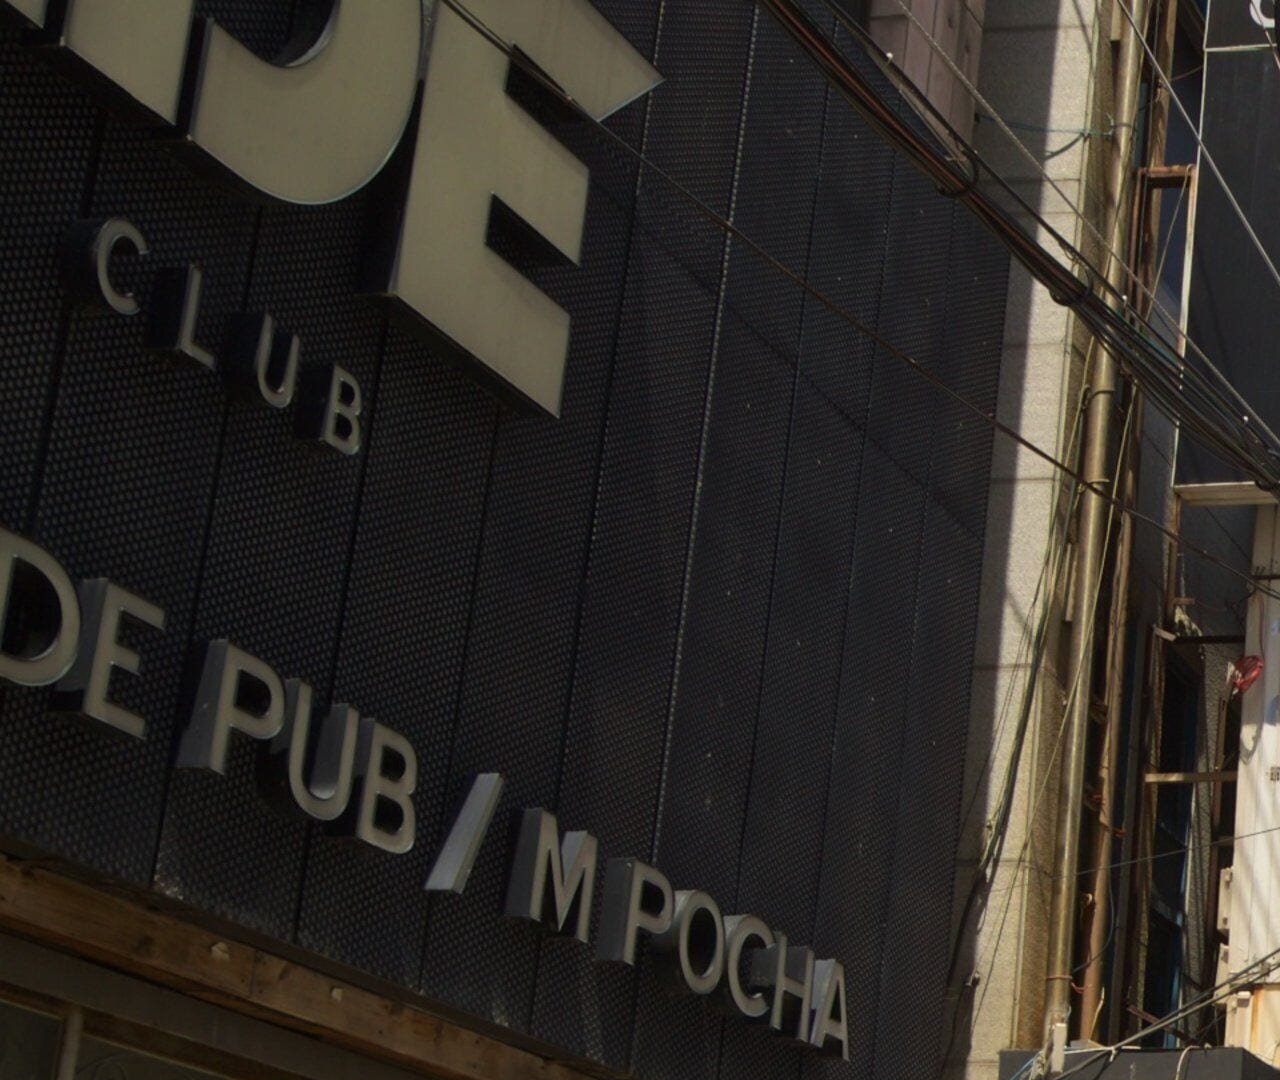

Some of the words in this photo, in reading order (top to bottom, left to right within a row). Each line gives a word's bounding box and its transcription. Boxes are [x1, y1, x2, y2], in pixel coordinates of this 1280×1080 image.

[90, 215, 364, 457] CLUB
[200, 638, 419, 855] PUB
[515, 807, 599, 945] M
[612, 857, 851, 1063] POCHA
